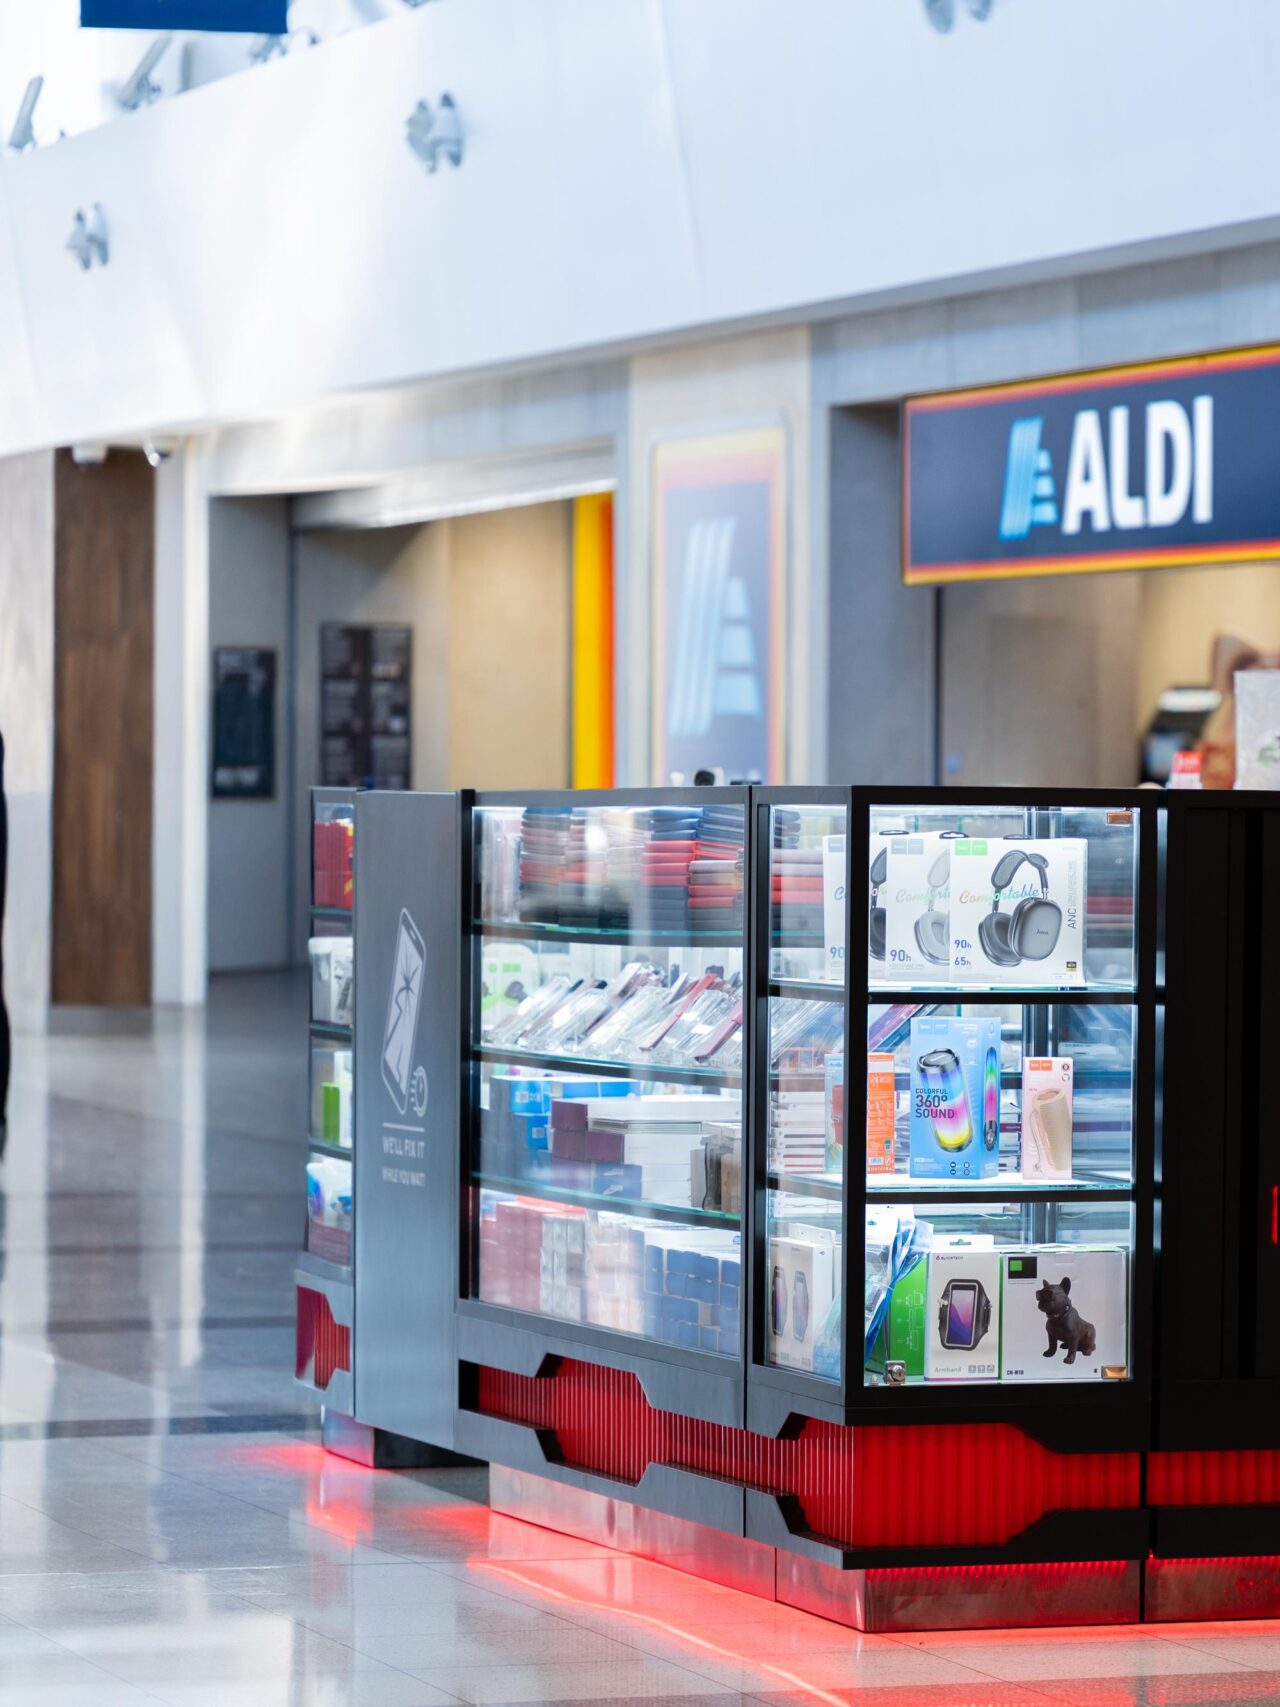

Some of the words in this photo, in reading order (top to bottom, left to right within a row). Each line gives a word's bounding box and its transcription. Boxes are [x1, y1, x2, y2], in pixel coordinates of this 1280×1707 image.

[1061, 394, 1213, 535] ALDI
[954, 939, 972, 949] 90h
[889, 949, 912, 963] 90h
[954, 956, 971, 966] 65h
[915, 1087, 948, 1095] COLORFUL
[915, 1108, 955, 1119] SOUND
[934, 1366, 962, 1374] Armband
